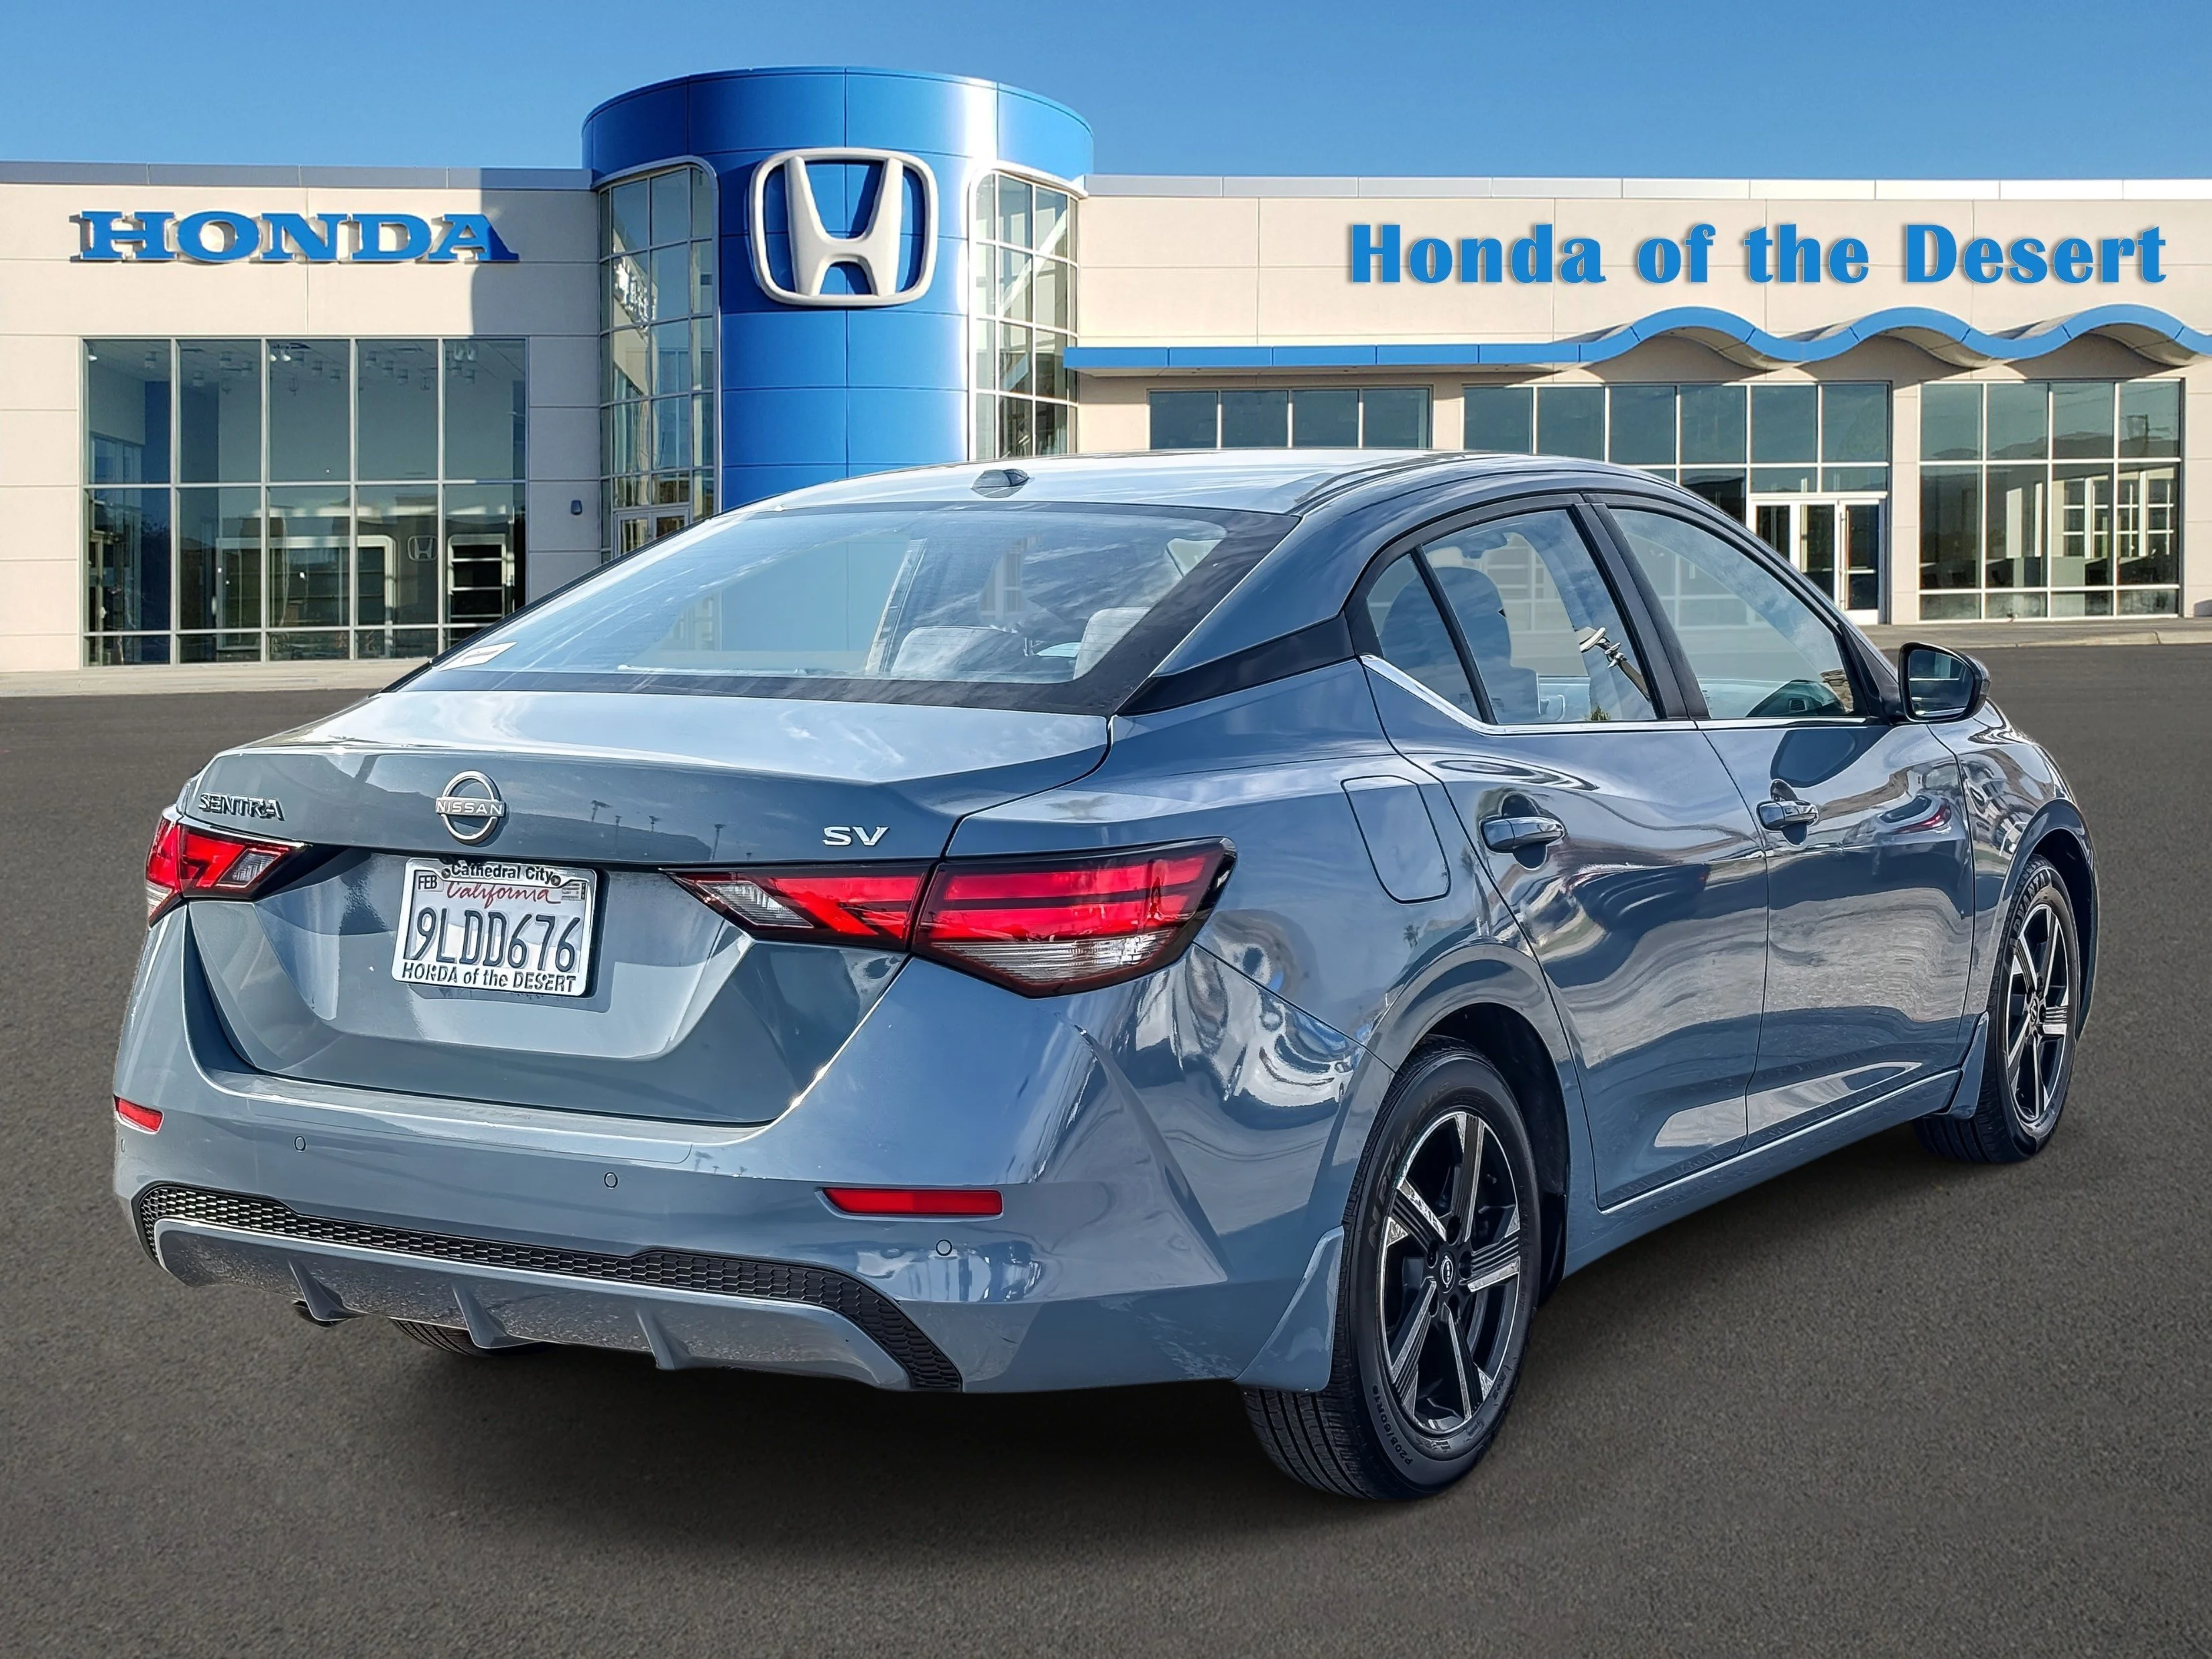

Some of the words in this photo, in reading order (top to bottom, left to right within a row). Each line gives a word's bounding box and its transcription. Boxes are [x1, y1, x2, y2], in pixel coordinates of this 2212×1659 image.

[78, 210, 519, 262] HONDA
[1351, 223, 1607, 284] Honda
[1638, 223, 1717, 284] of
[1743, 223, 1869, 284] the
[1906, 224, 2168, 284] Desert
[199, 792, 284, 821] SENTRA
[436, 800, 503, 815] NISSAN
[822, 826, 889, 847] SV
[418, 874, 438, 891] FEB
[451, 862, 521, 879] Cathedral
[526, 866, 554, 885] City
[447, 881, 561, 909] California
[413, 907, 580, 972] 9LDD676
[463, 968, 479, 985] of
[483, 969, 508, 987] the
[513, 971, 576, 992] DESERT
